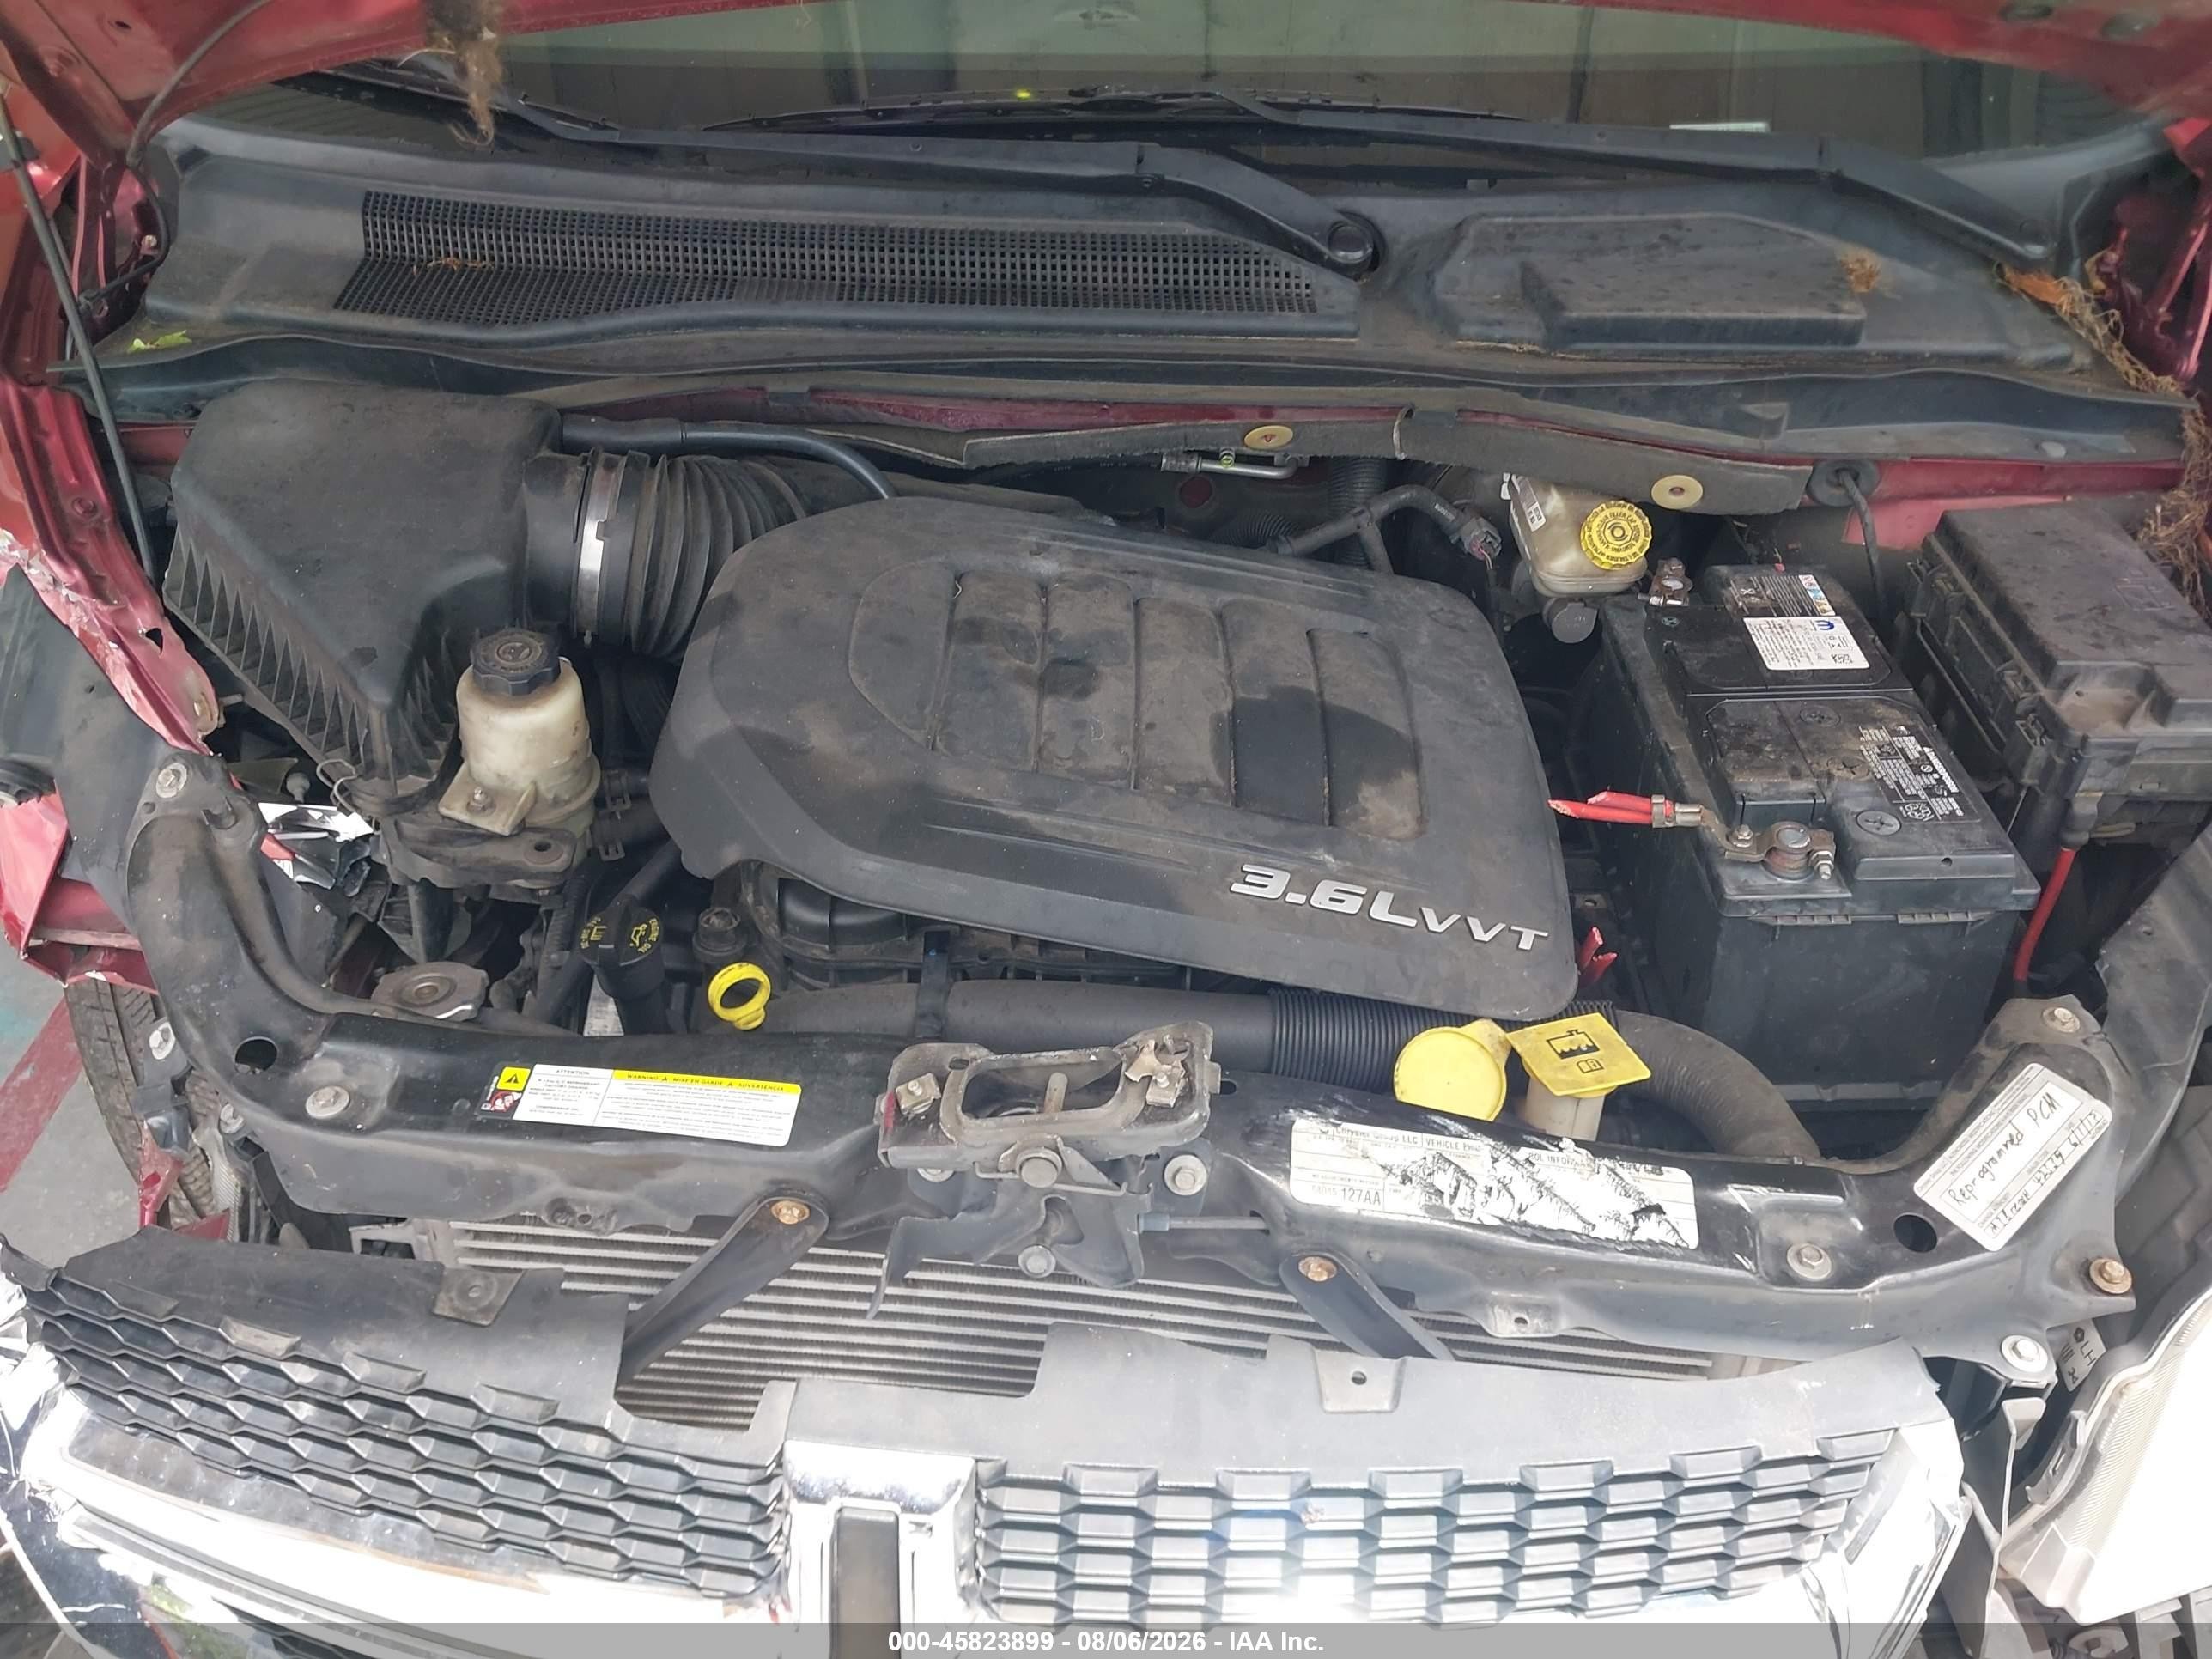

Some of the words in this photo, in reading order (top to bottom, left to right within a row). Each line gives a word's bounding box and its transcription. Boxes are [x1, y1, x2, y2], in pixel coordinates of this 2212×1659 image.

[1230, 863, 1419, 929] 3.6L
[1419, 906, 1549, 951] VVT
[638, 942, 652, 953] OIL
[2027, 1091, 2063, 1128] PCM
[1402, 1134, 1419, 1145] LLC
[1426, 1138, 1459, 1151] VEHICLE
[1341, 1187, 1381, 1206] 127AA
[2080, 1340, 2097, 1367] LH
